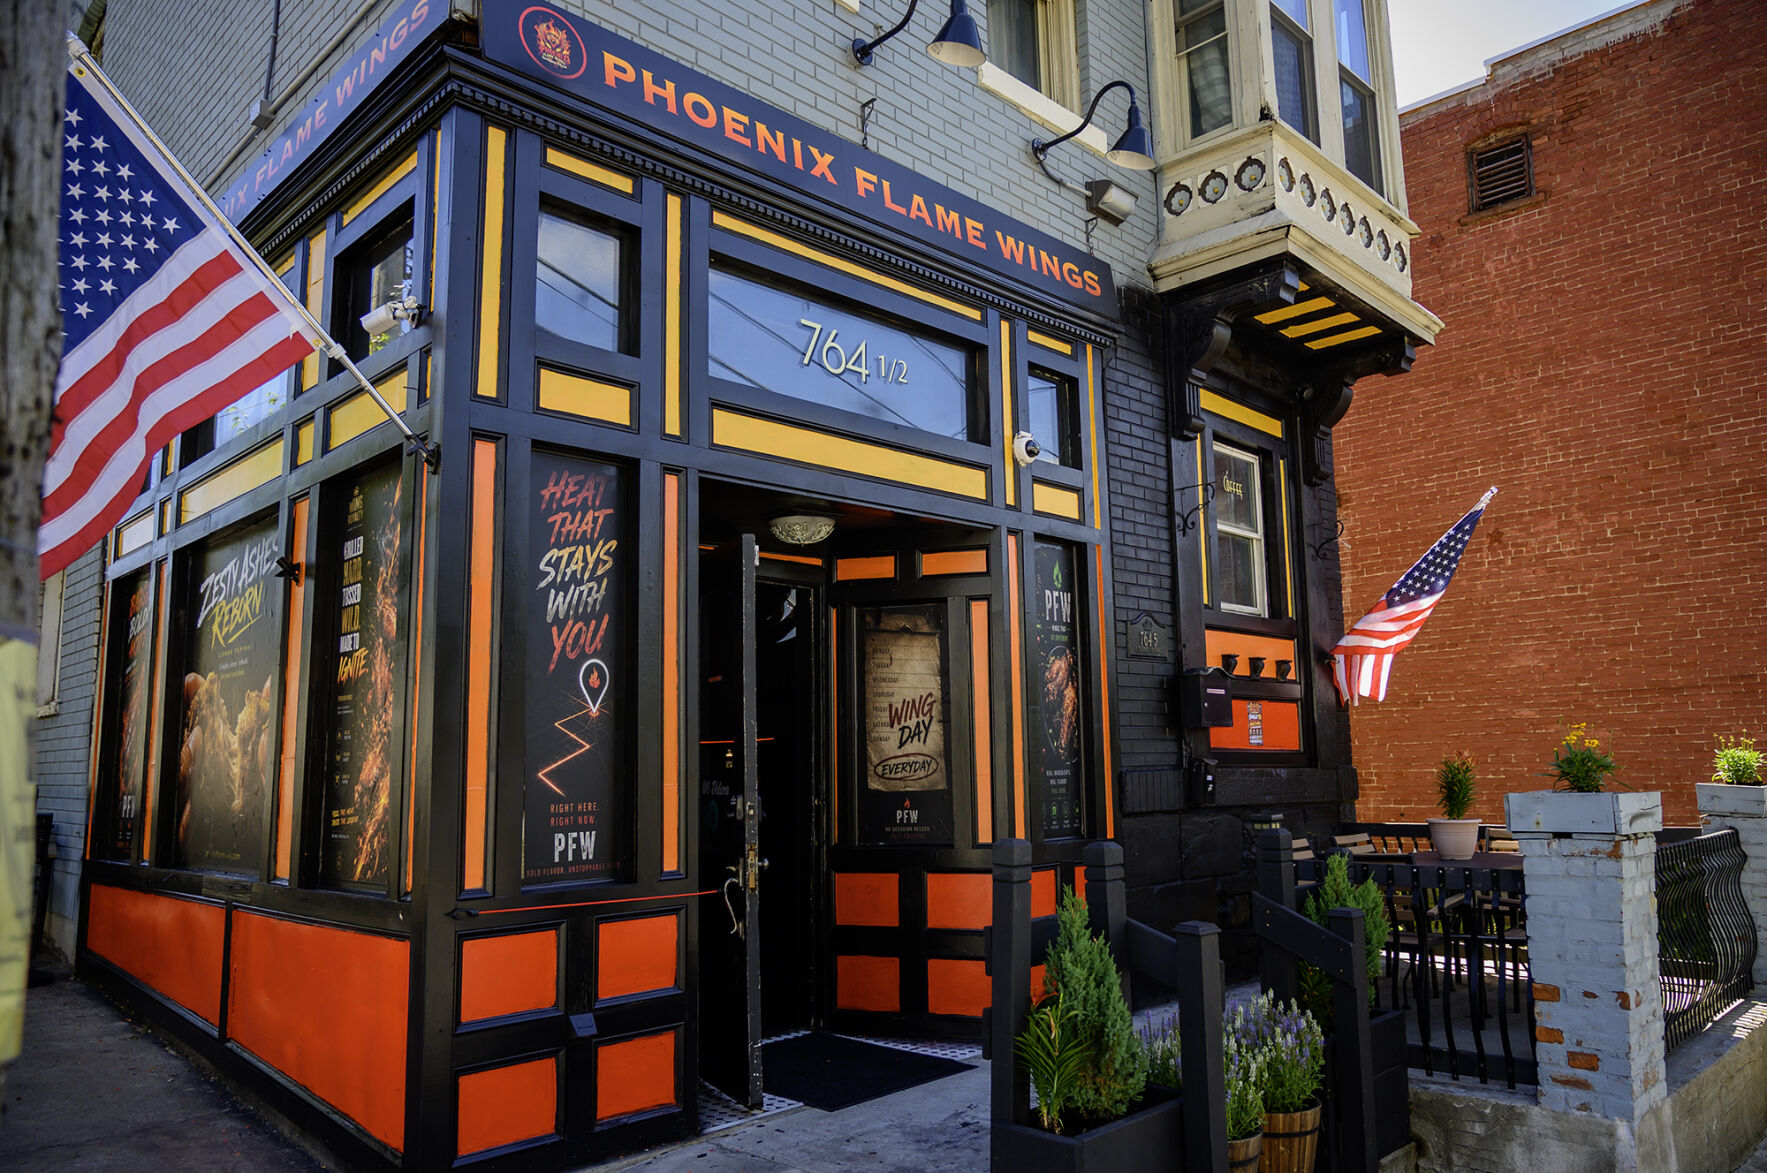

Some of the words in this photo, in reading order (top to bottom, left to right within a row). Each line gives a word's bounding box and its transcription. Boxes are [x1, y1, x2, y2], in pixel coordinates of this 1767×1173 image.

[255, 99, 329, 193] FLAME
[336, 0, 430, 108] WINGS
[601, 50, 839, 186] PHOENIX
[854, 166, 987, 251] FLAME
[995, 230, 1102, 297] WINGS
[800, 318, 870, 383] 764
[878, 355, 908, 384] 1/2
[540, 470, 614, 513] HEAT
[547, 508, 615, 546] THAT
[536, 538, 618, 591] STAYS
[196, 555, 240, 629] ZESTY
[546, 577, 608, 624] WITH
[1044, 589, 1071, 623] PFW
[207, 580, 264, 650] REBORN
[548, 613, 610, 678] YOU
[872, 705, 888, 713] FRIDAY
[872, 720, 891, 728] SATURD
[888, 691, 937, 729] WING
[897, 716, 934, 750] DAY
[881, 759, 933, 777] EVERYDAY
[550, 803, 574, 814] RIGHT
[550, 816, 574, 827] RIGHT
[896, 809, 918, 824] PFW
[554, 831, 597, 863] PFW
